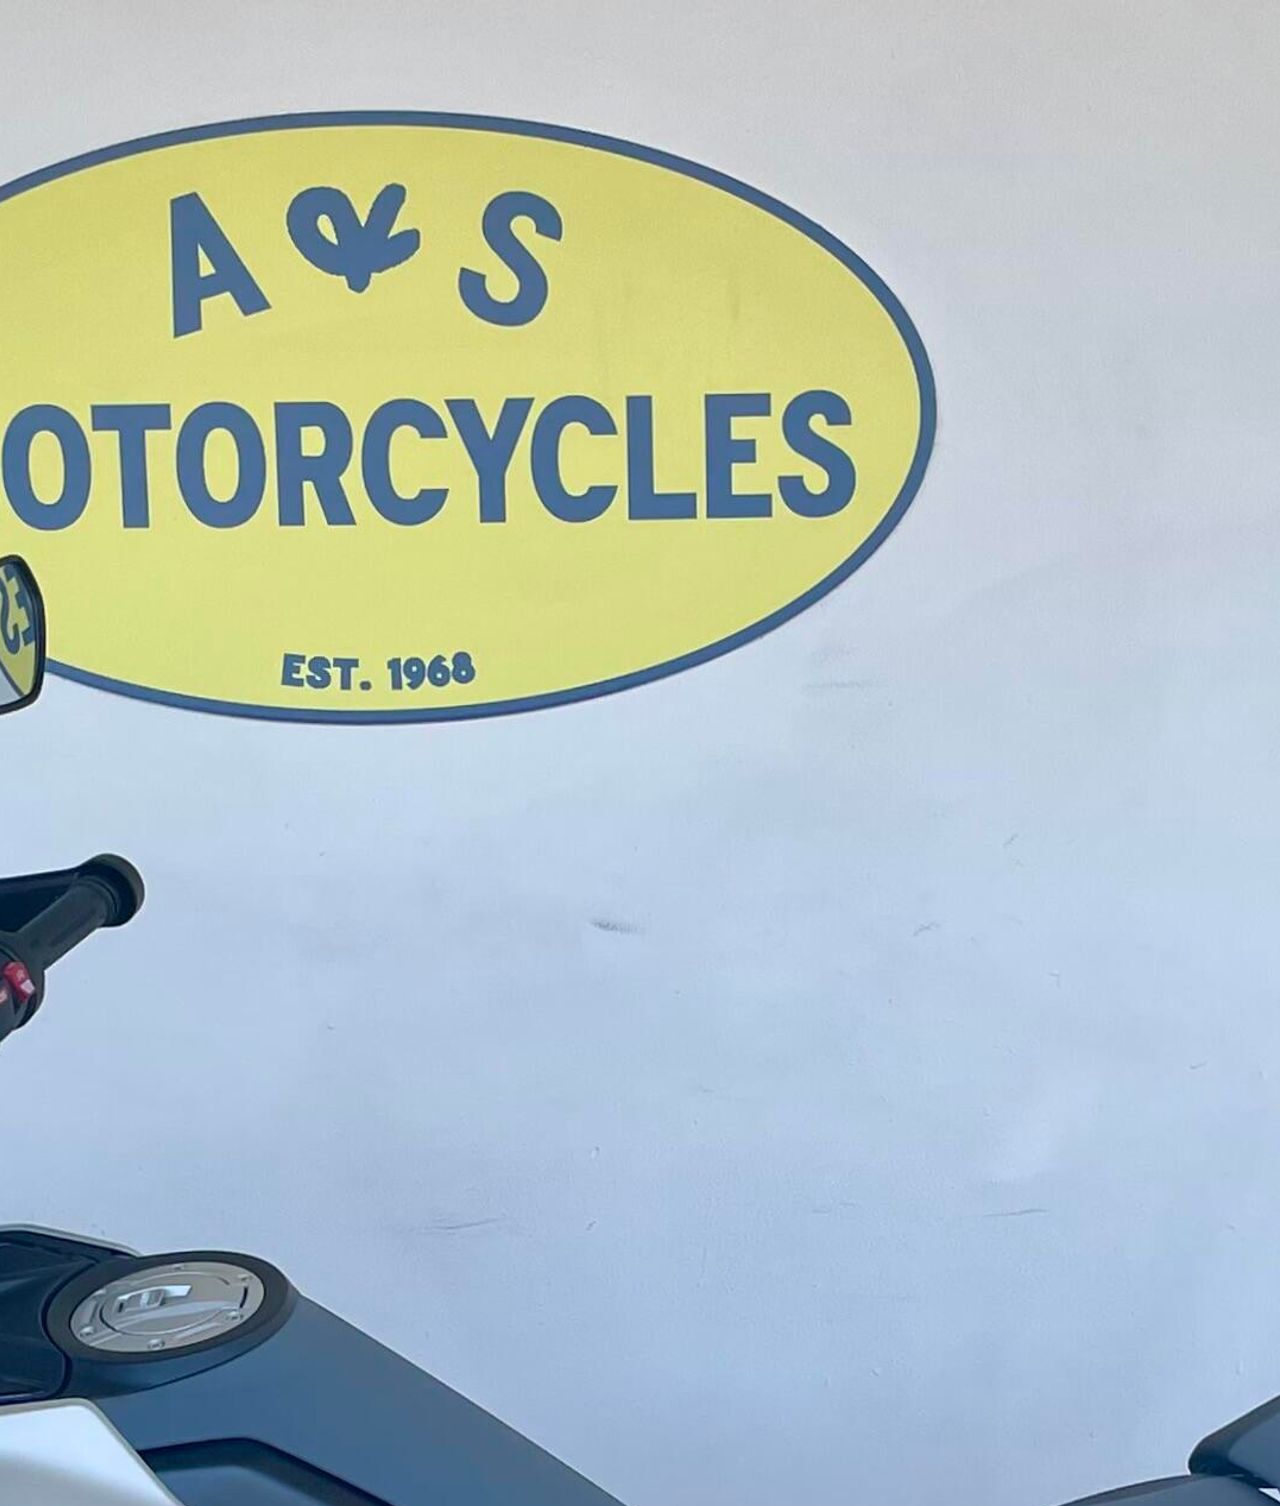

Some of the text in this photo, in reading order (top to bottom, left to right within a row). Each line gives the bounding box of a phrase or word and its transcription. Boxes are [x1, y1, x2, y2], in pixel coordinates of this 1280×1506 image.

[170, 192, 272, 338] A
[458, 191, 562, 327] S
[281, 651, 476, 691] EST. 1968
